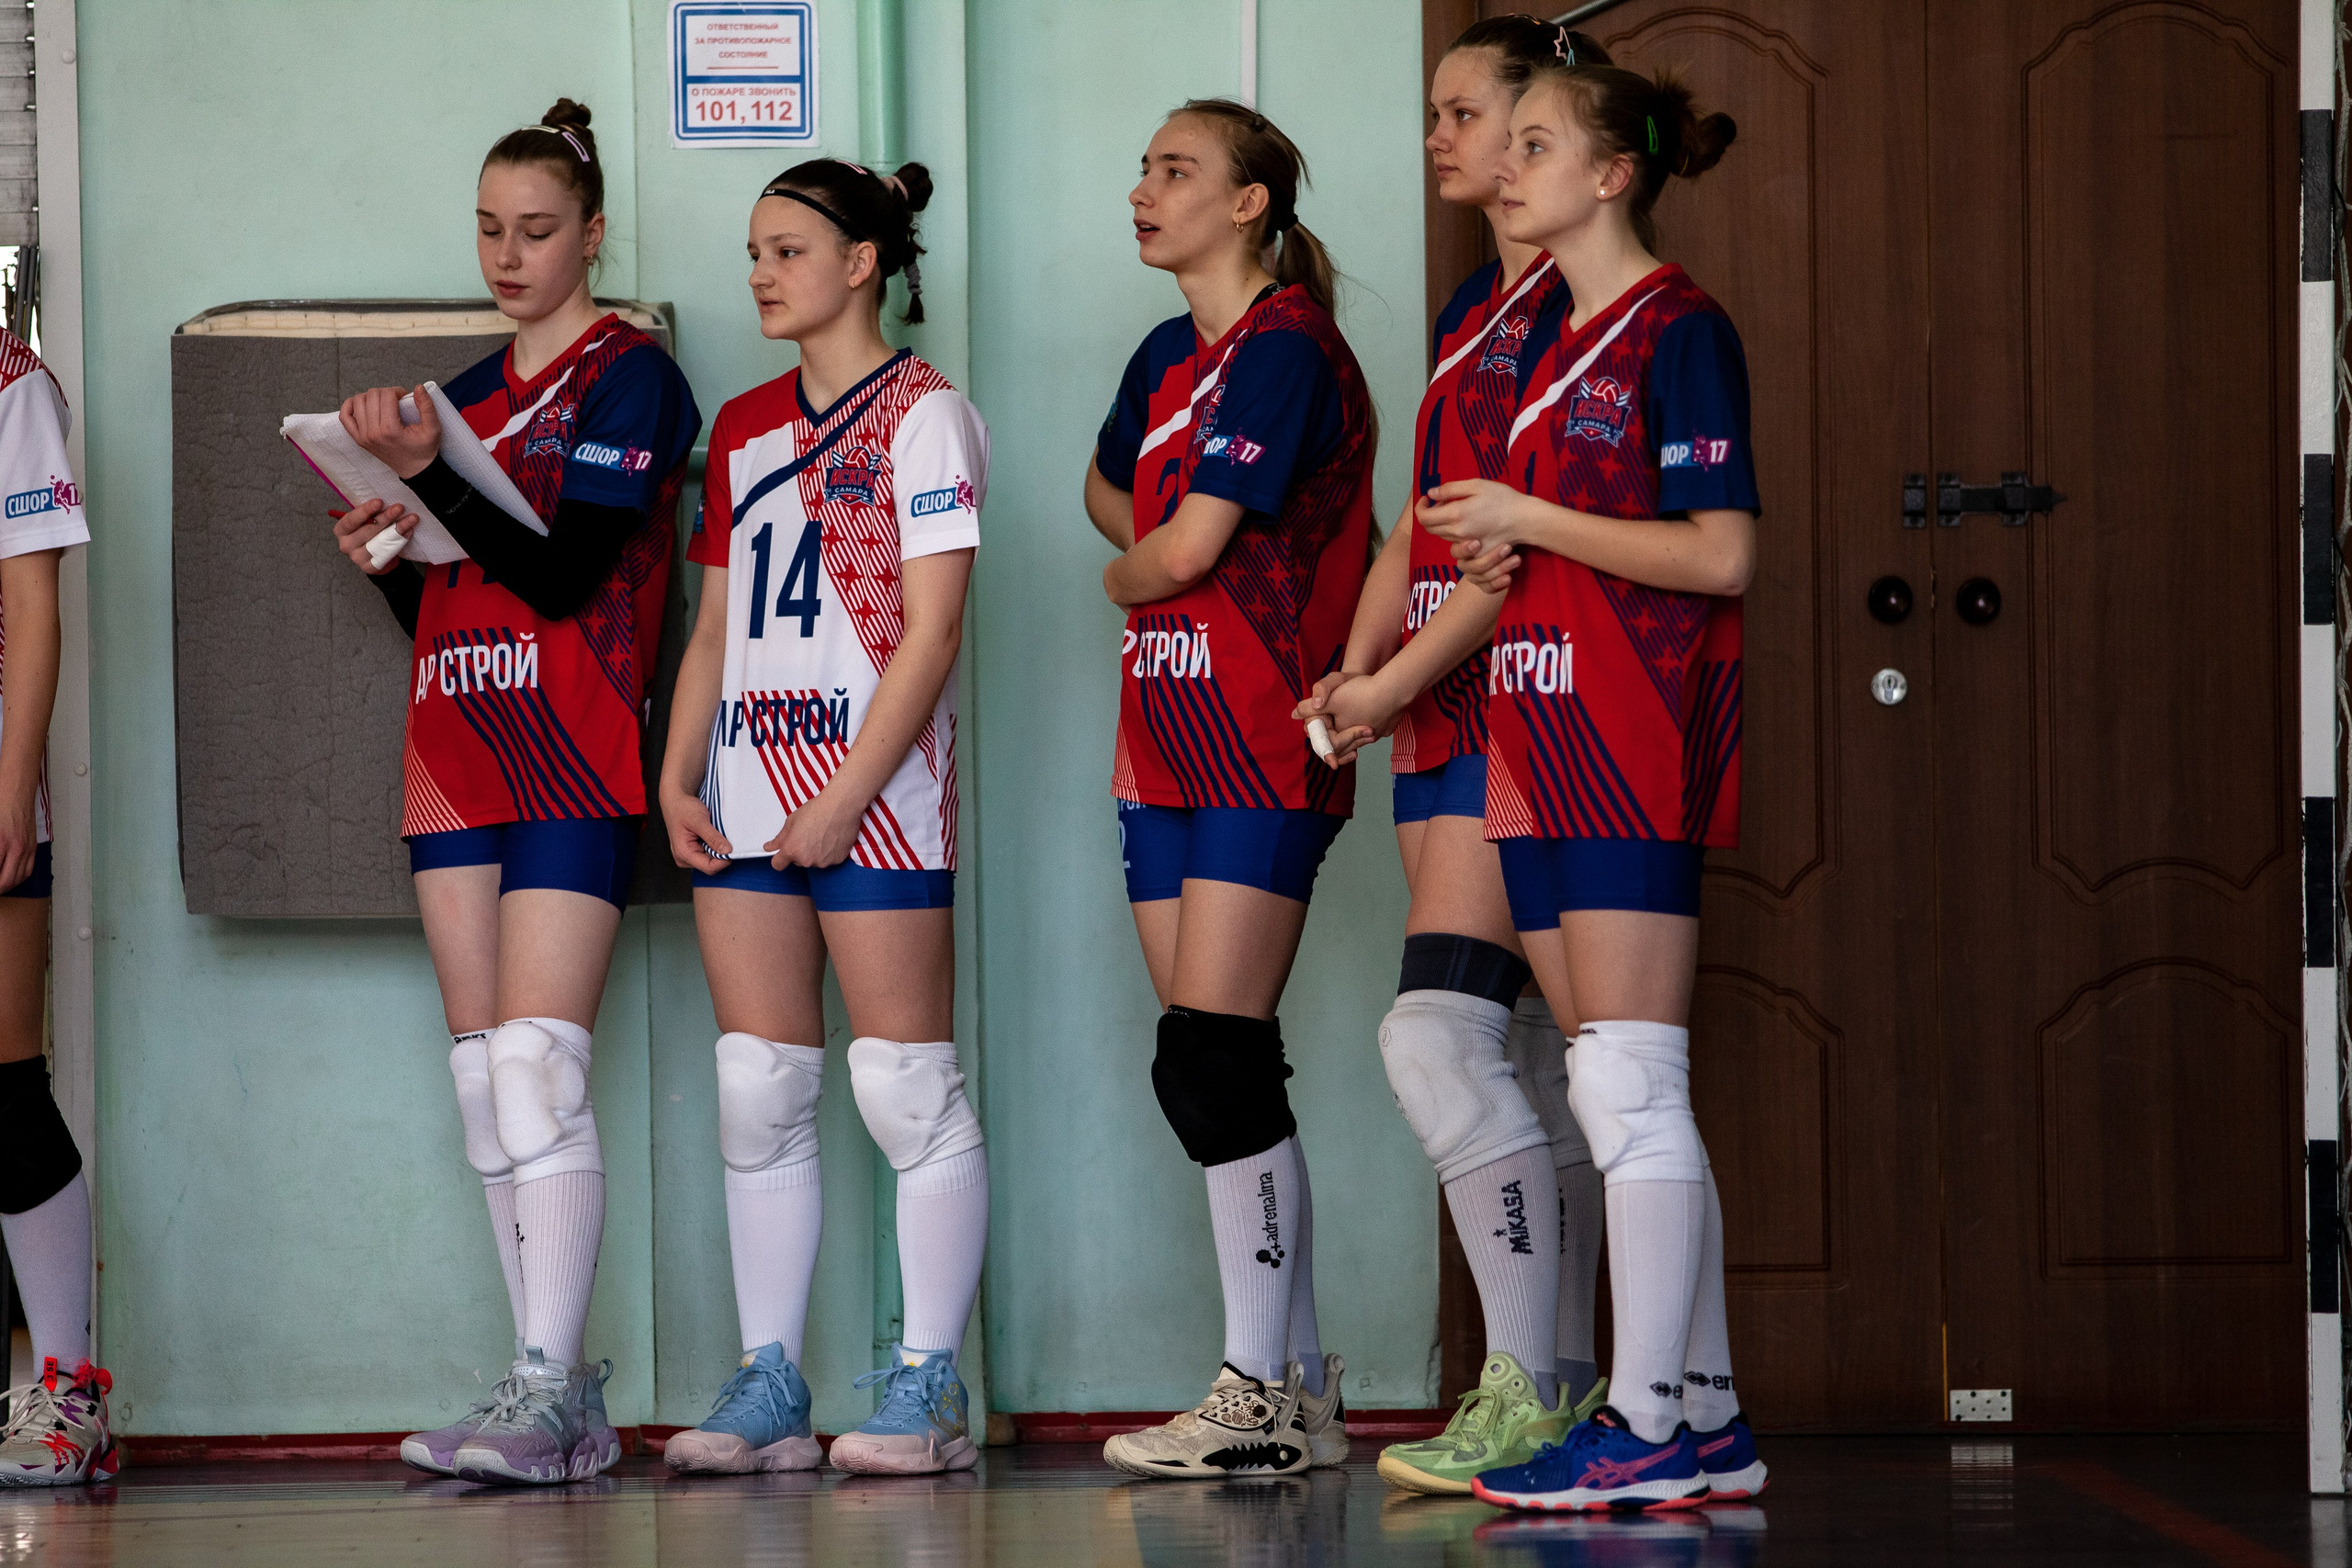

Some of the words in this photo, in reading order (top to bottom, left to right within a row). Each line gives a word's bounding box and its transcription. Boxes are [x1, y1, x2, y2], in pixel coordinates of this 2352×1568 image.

[707, 23, 779, 31] ОТВЕТСТВЕННЫЙ
[691, 88, 699, 96] О
[702, 87, 745, 96] ПОЖАРЕ
[748, 87, 797, 96] ЗВОНИТЬ
[1574, 399, 1623, 428] ИСКРА
[1577, 419, 1611, 433] САМАРА
[575, 443, 620, 467] СШОР
[635, 450, 652, 469] 17
[1239, 442, 1261, 463] 17
[1710, 440, 1728, 463] 17
[830, 468, 875, 490] ИСКРА
[834, 487, 868, 496] САМАРА
[7, 491, 51, 517] СШОР
[913, 491, 954, 515] СШОР
[748, 520, 822, 639] 14
